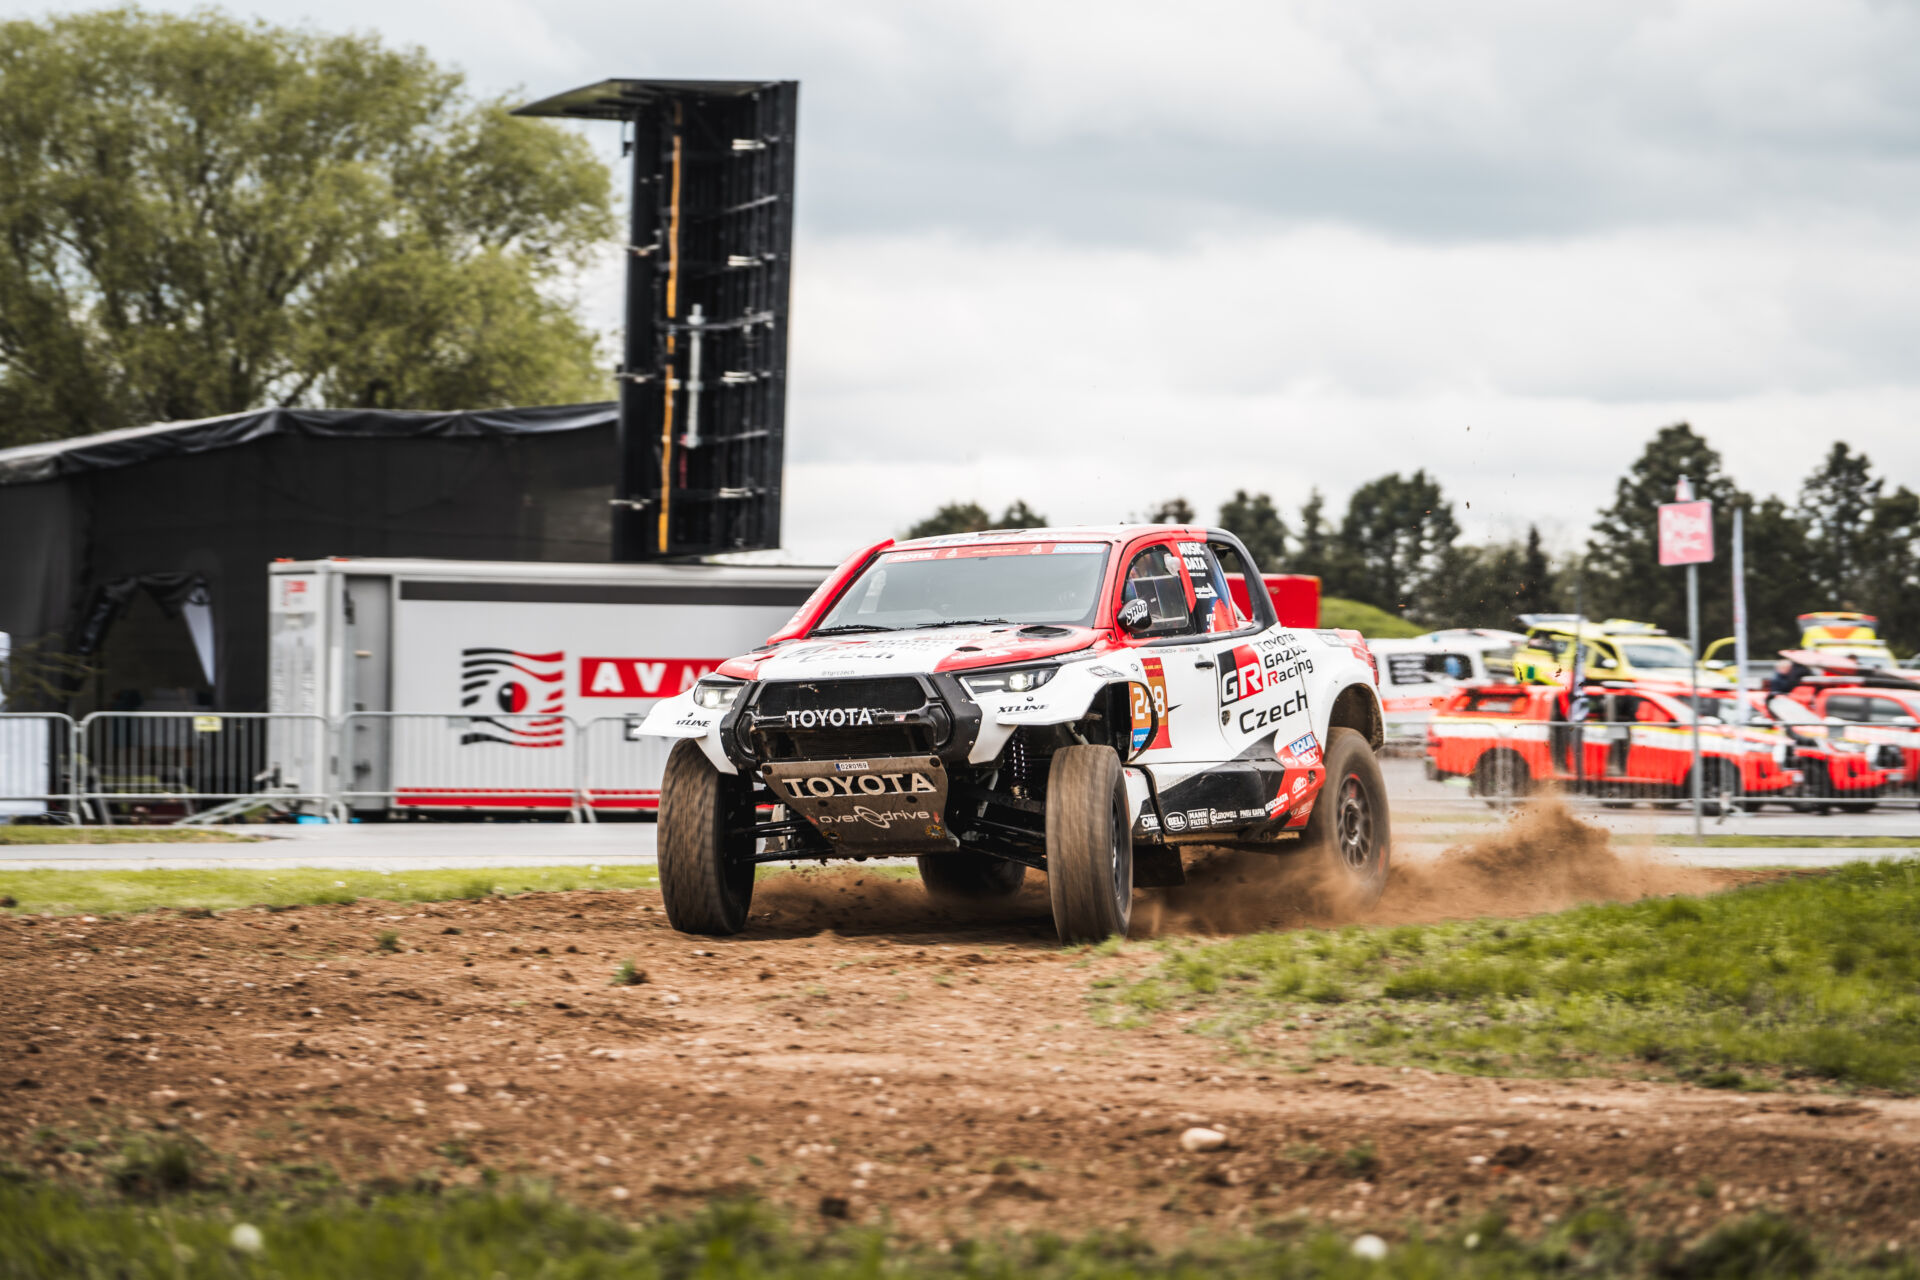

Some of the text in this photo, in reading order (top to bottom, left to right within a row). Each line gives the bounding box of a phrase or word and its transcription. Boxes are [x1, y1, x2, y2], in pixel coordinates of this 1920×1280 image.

[1183, 557, 1208, 570] DATA
[1126, 603, 1147, 623] SHOT
[1255, 634, 1297, 652] TOYOTA
[1221, 662, 1263, 703] GR
[1267, 659, 1313, 687] Racing
[787, 707, 873, 728] TOYOTA
[997, 704, 1050, 717] XTLINE
[1239, 690, 1308, 734] Czech
[1290, 734, 1316, 757] LIQUI
[782, 773, 937, 798] TOYOTA
[1167, 815, 1185, 826] BELL
[1190, 811, 1207, 819] MANN
